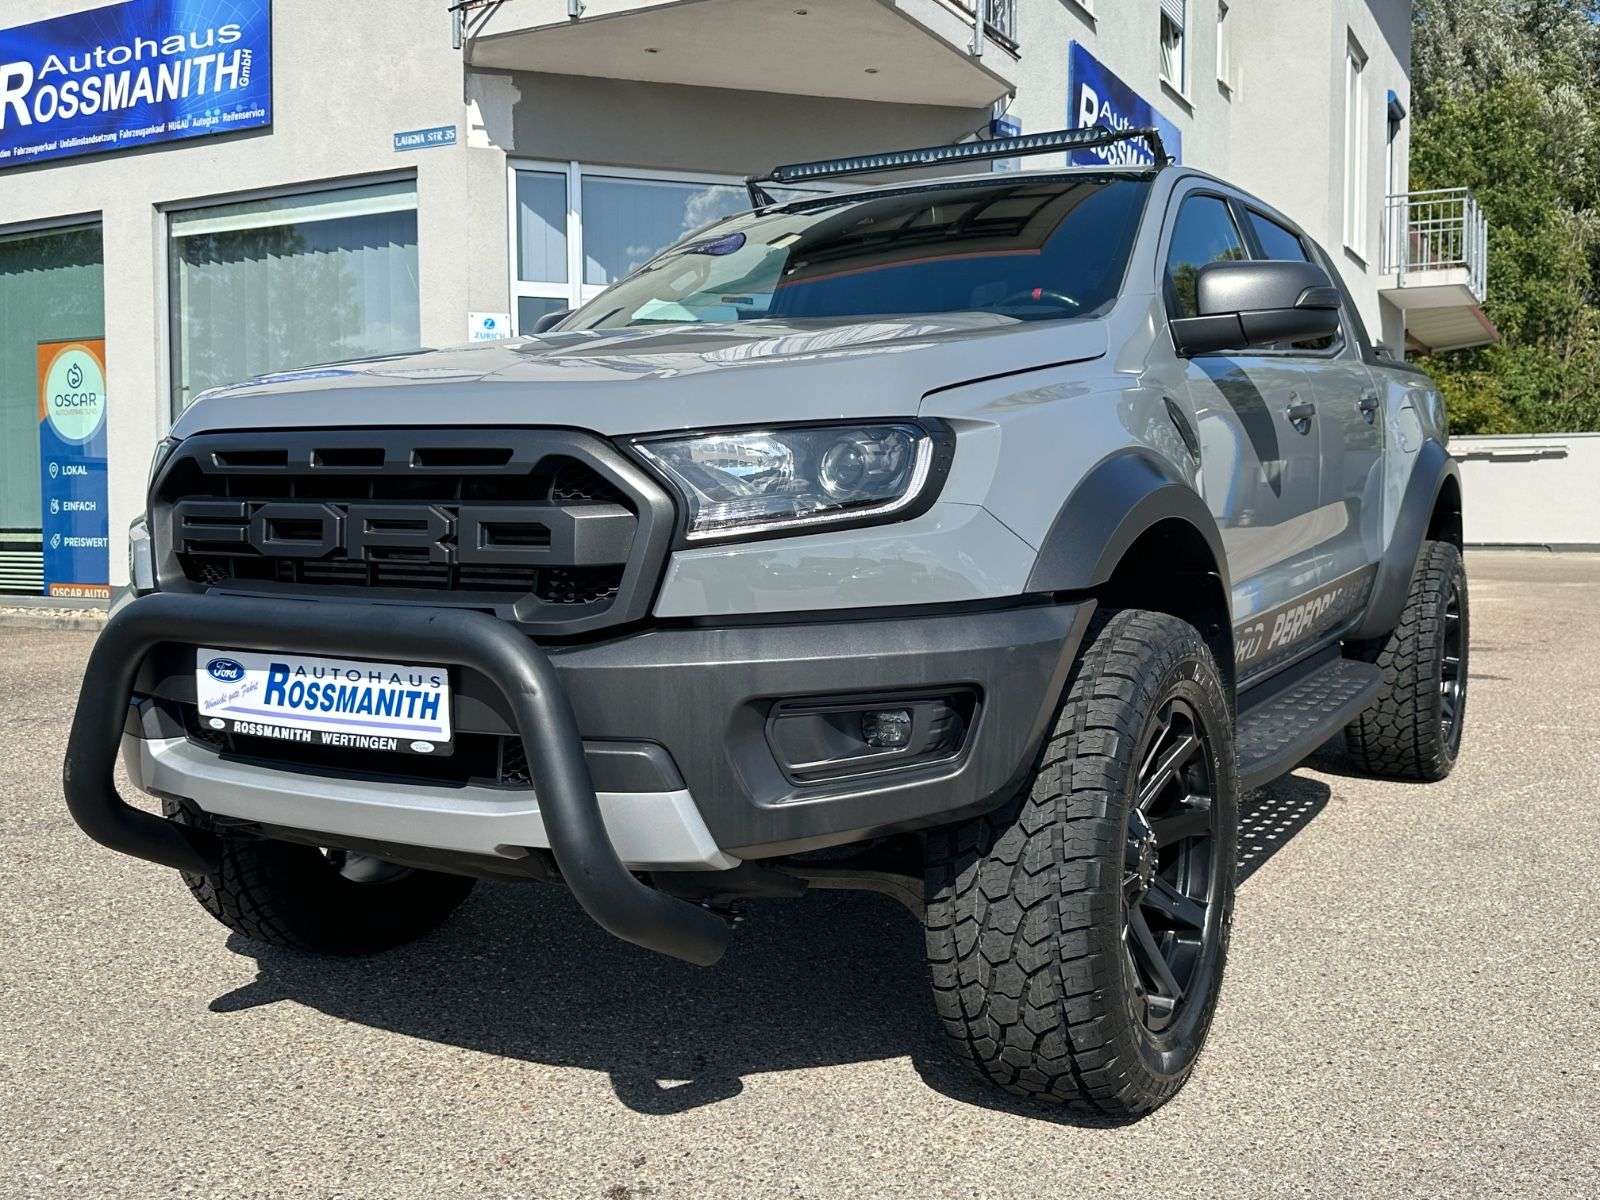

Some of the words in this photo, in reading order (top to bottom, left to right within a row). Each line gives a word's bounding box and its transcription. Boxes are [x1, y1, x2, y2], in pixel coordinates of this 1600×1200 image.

[37, 23, 242, 80] Autohaus
[239, 48, 253, 88] GmbH
[0, 48, 242, 130] ROSSMANITH
[119, 125, 165, 141] Fahrzeugankauf
[222, 108, 265, 123] Reifenservice
[444, 129, 455, 140] 35
[54, 392, 97, 407] OSCAR
[62, 464, 88, 476] LOKAL
[63, 500, 96, 511] EINFACH
[64, 537, 108, 548] PREISWERT
[173, 500, 592, 566] FORD
[212, 661, 241, 680] Ford
[295, 665, 441, 688] AUTOHAUS
[263, 662, 441, 721] ROSSMANITH
[233, 720, 312, 742] ROSSMANITH
[321, 732, 398, 751] WERTINGEN
